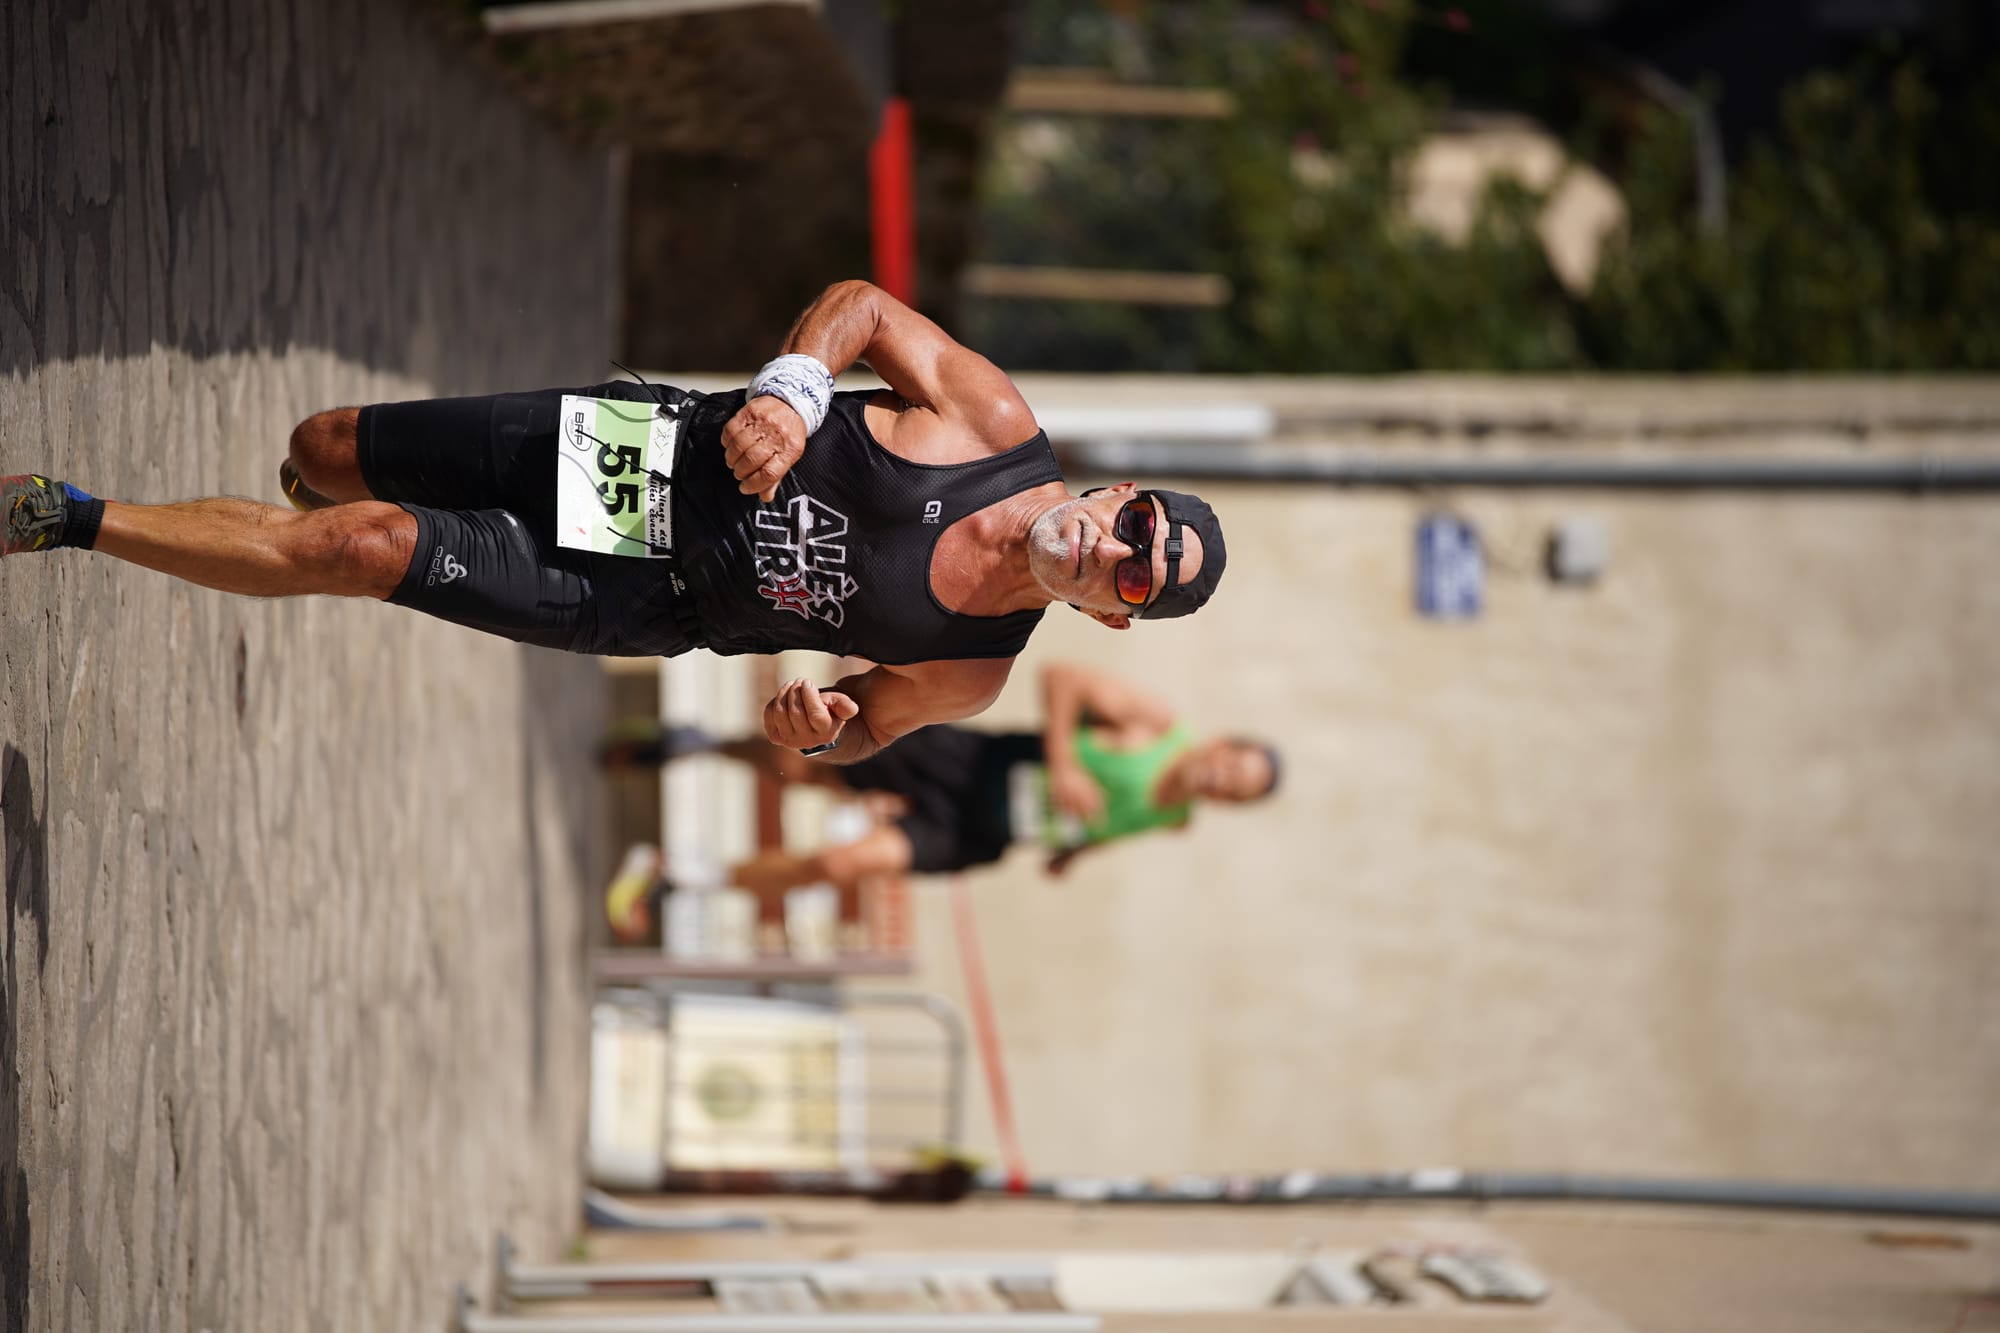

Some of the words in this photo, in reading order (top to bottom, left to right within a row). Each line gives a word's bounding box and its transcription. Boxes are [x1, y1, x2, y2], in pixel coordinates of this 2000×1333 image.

[597, 443, 642, 516] 55
[656, 481, 667, 523] hallenge
[649, 508, 658, 546] cévenol
[659, 529, 668, 546] des
[428, 546, 443, 585] odlo
[804, 495, 859, 629] ALÈS
